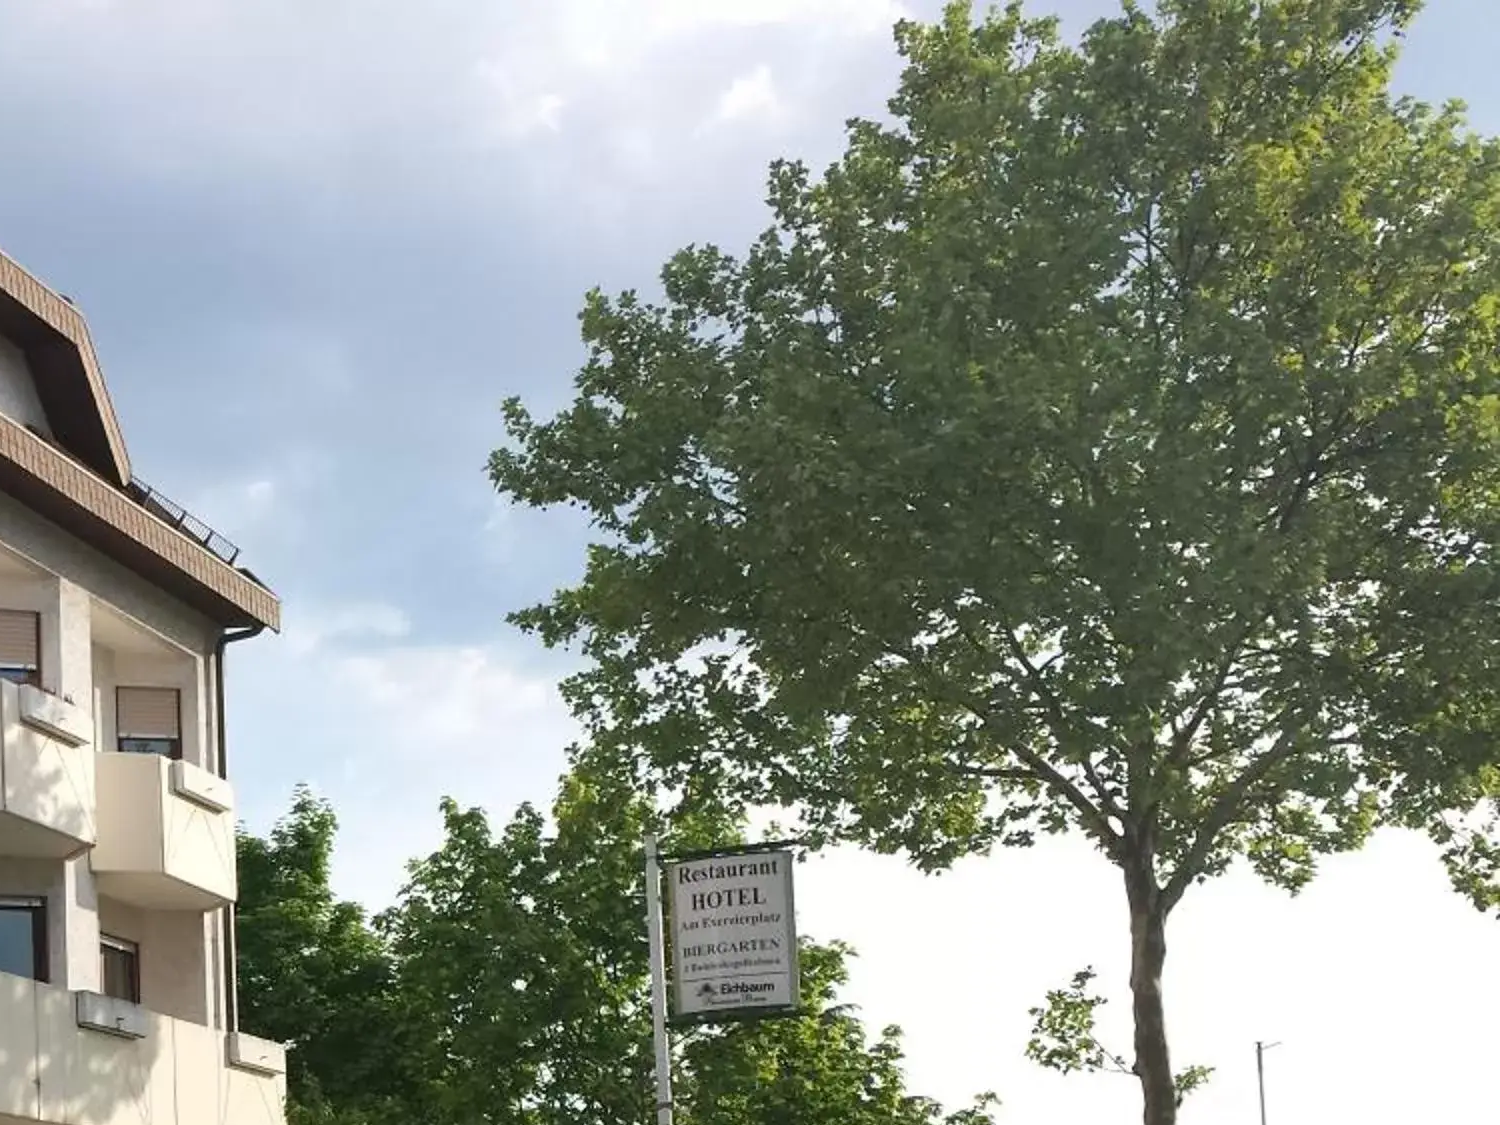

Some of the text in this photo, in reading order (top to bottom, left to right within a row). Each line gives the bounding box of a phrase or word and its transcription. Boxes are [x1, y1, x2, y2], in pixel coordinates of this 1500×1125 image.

[678, 860, 778, 885] Restaurant
[692, 887, 767, 911] HOTEL
[683, 937, 781, 957] BIERGARTEN
[720, 982, 775, 995] Eichbaum
